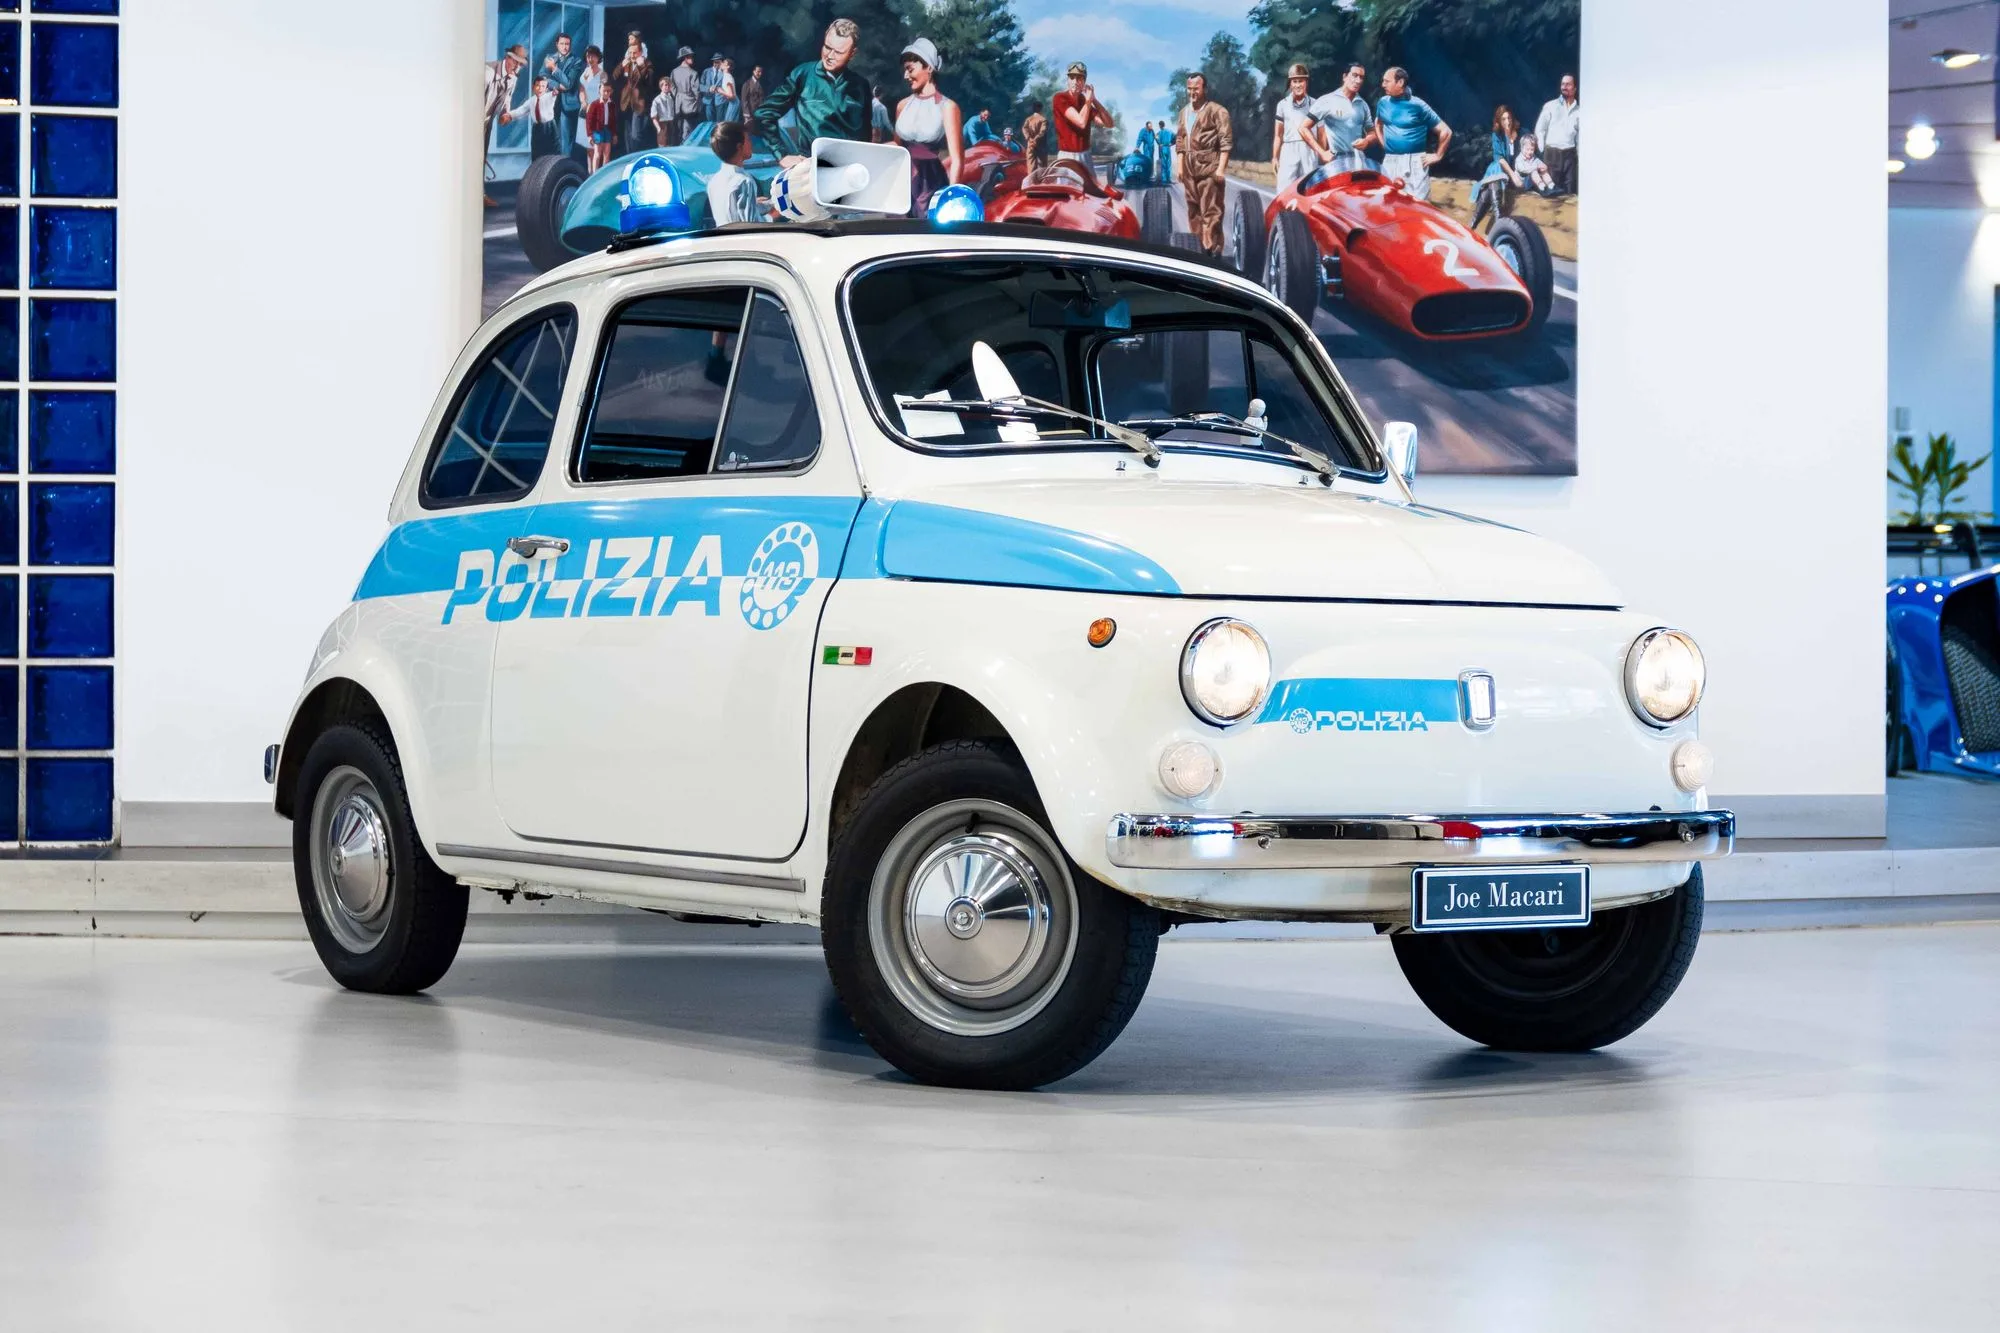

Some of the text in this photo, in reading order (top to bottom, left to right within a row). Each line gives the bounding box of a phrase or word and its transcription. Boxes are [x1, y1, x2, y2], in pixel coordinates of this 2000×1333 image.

[1424, 239, 1479, 276] 2
[441, 536, 723, 625] POLIZIA
[760, 561, 801, 590] 113
[1316, 710, 1429, 731] POLIZIA
[1444, 881, 1564, 912] Joe Macari
